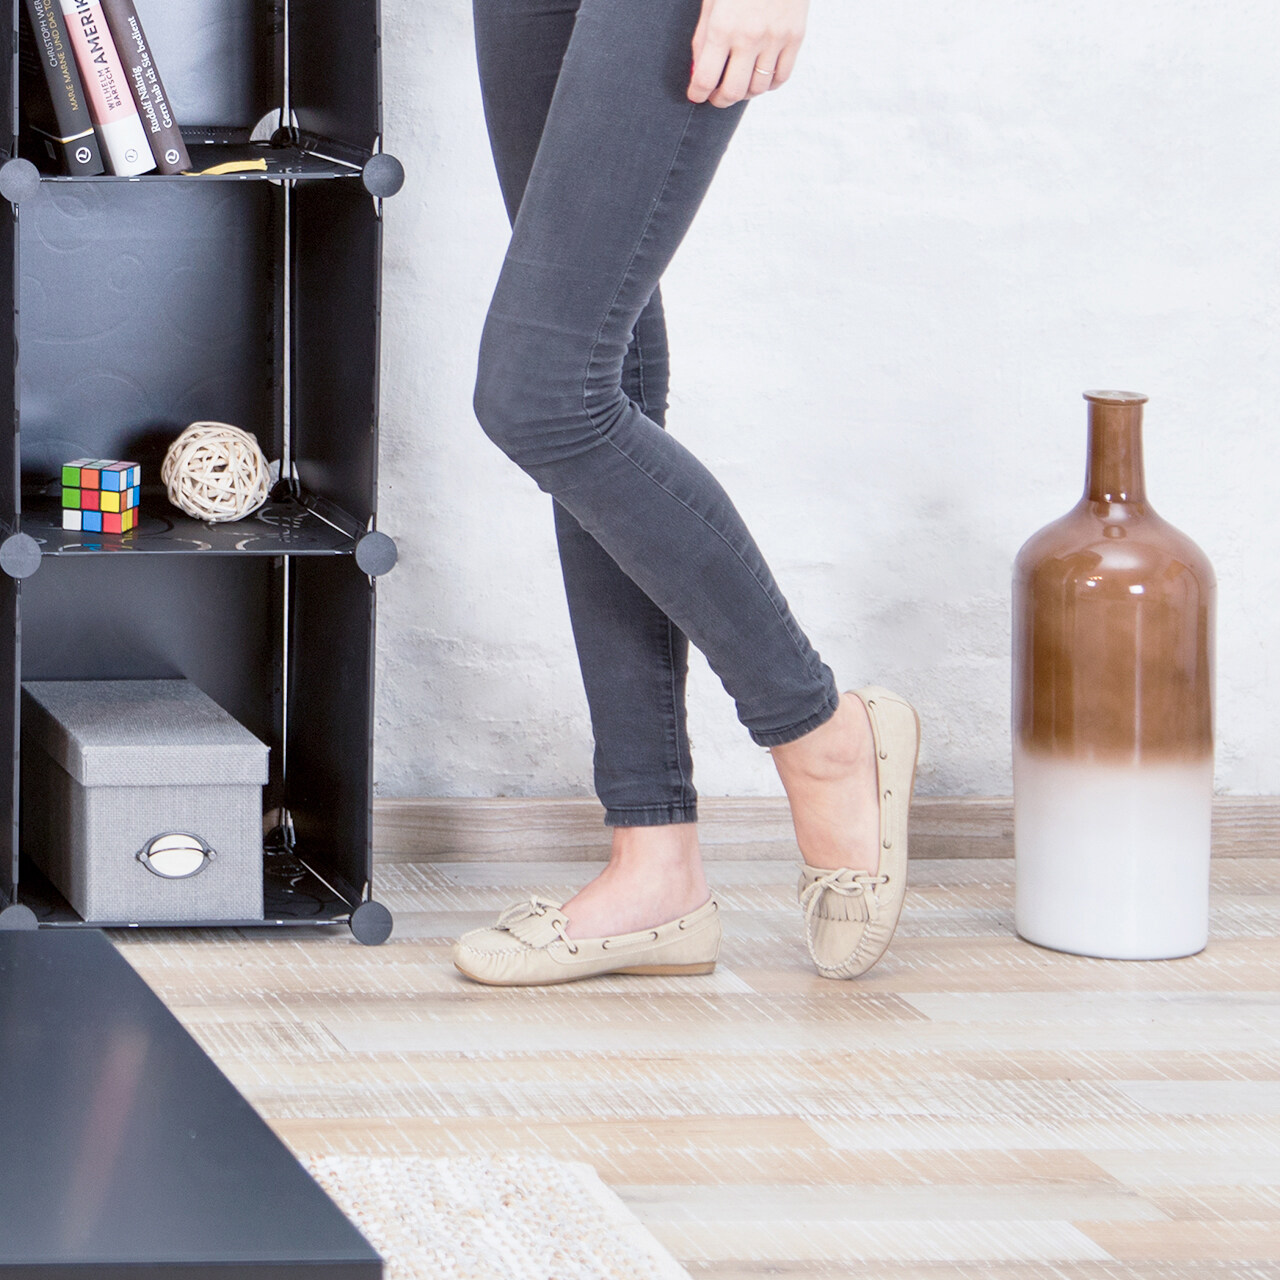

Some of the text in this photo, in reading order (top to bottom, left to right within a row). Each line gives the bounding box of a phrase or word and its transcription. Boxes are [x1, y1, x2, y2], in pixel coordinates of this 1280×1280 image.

[47, 11, 57, 29] DAS
[40, 19, 58, 67] CHRISTOPH
[52, 29, 63, 50] UND
[57, 52, 71, 83] MARNE
[128, 16, 173, 128] Gern hab ich Sie bedient
[65, 84, 78, 111] MARIE
[97, 69, 115, 111] WILHELM
[104, 67, 122, 106] BARTSCH
[141, 100, 161, 133] Rudolf
